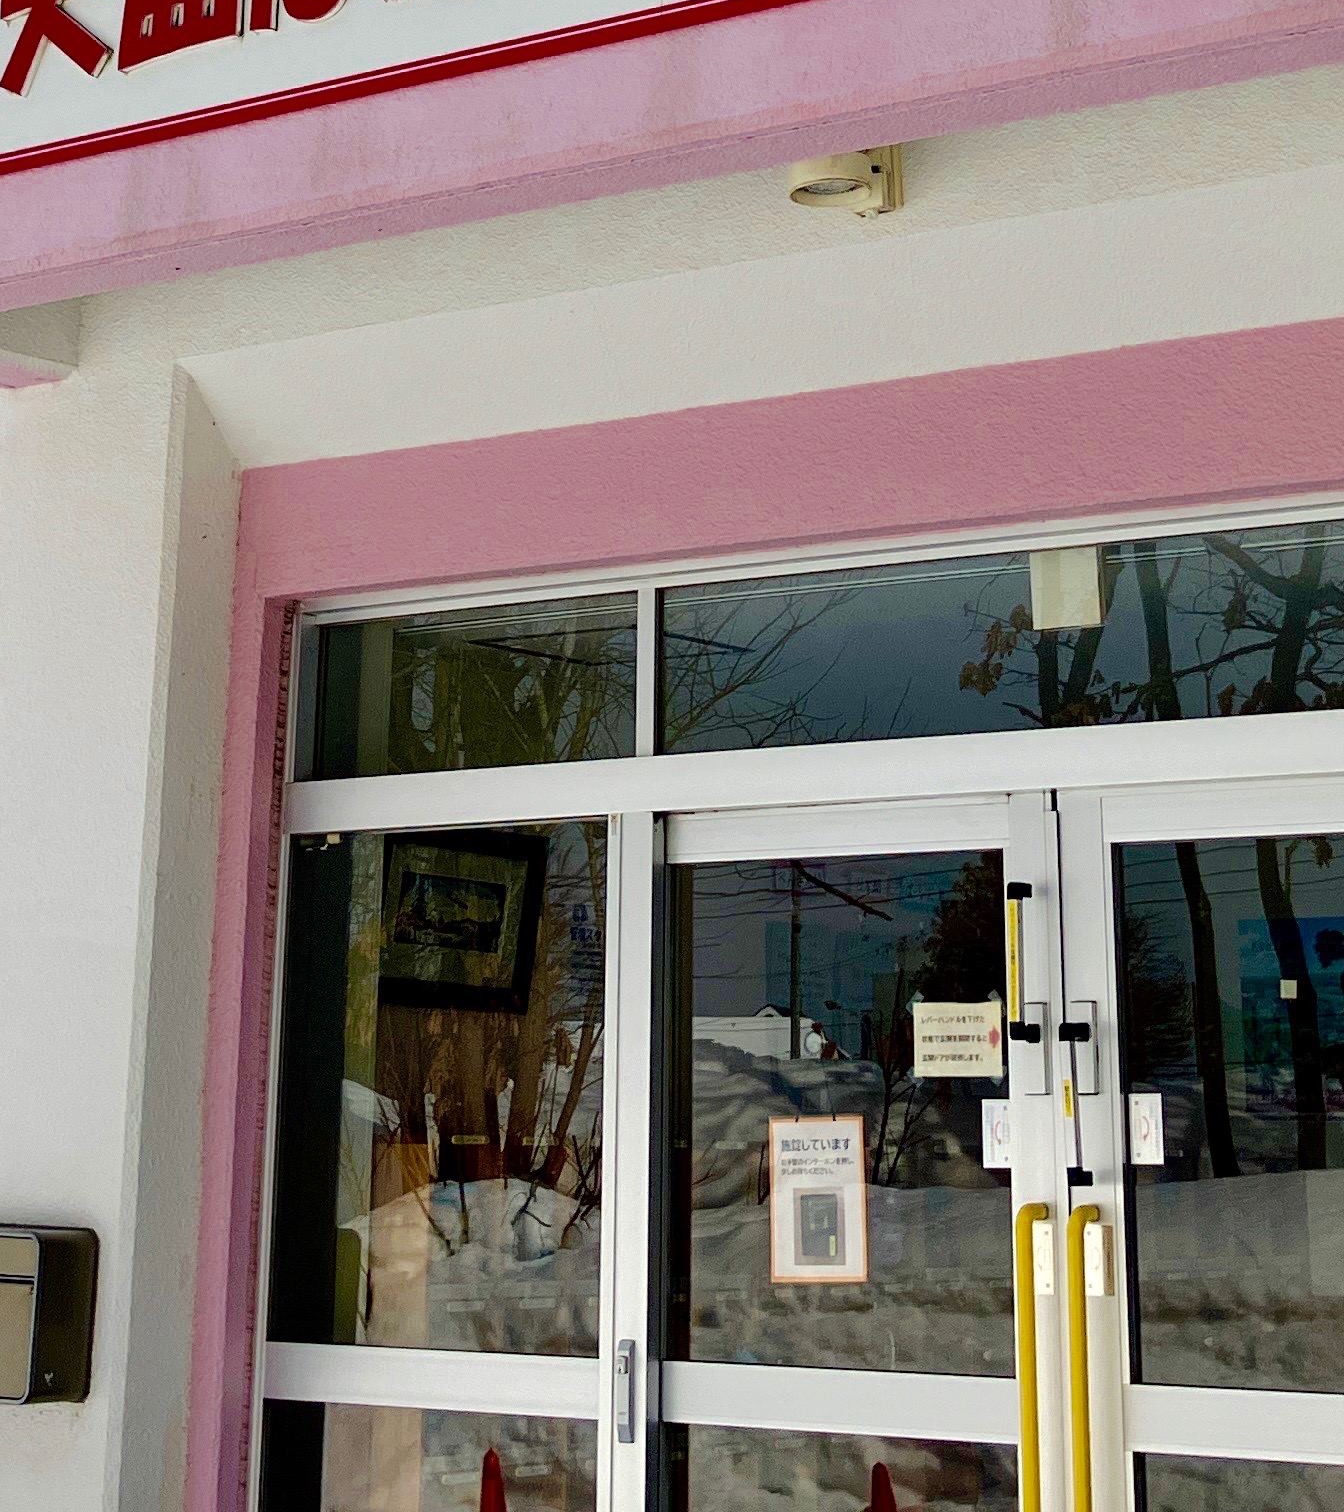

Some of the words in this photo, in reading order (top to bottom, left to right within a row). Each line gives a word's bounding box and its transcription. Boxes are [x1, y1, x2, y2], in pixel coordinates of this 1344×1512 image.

[781, 1137, 851, 1152] 施錠しています
